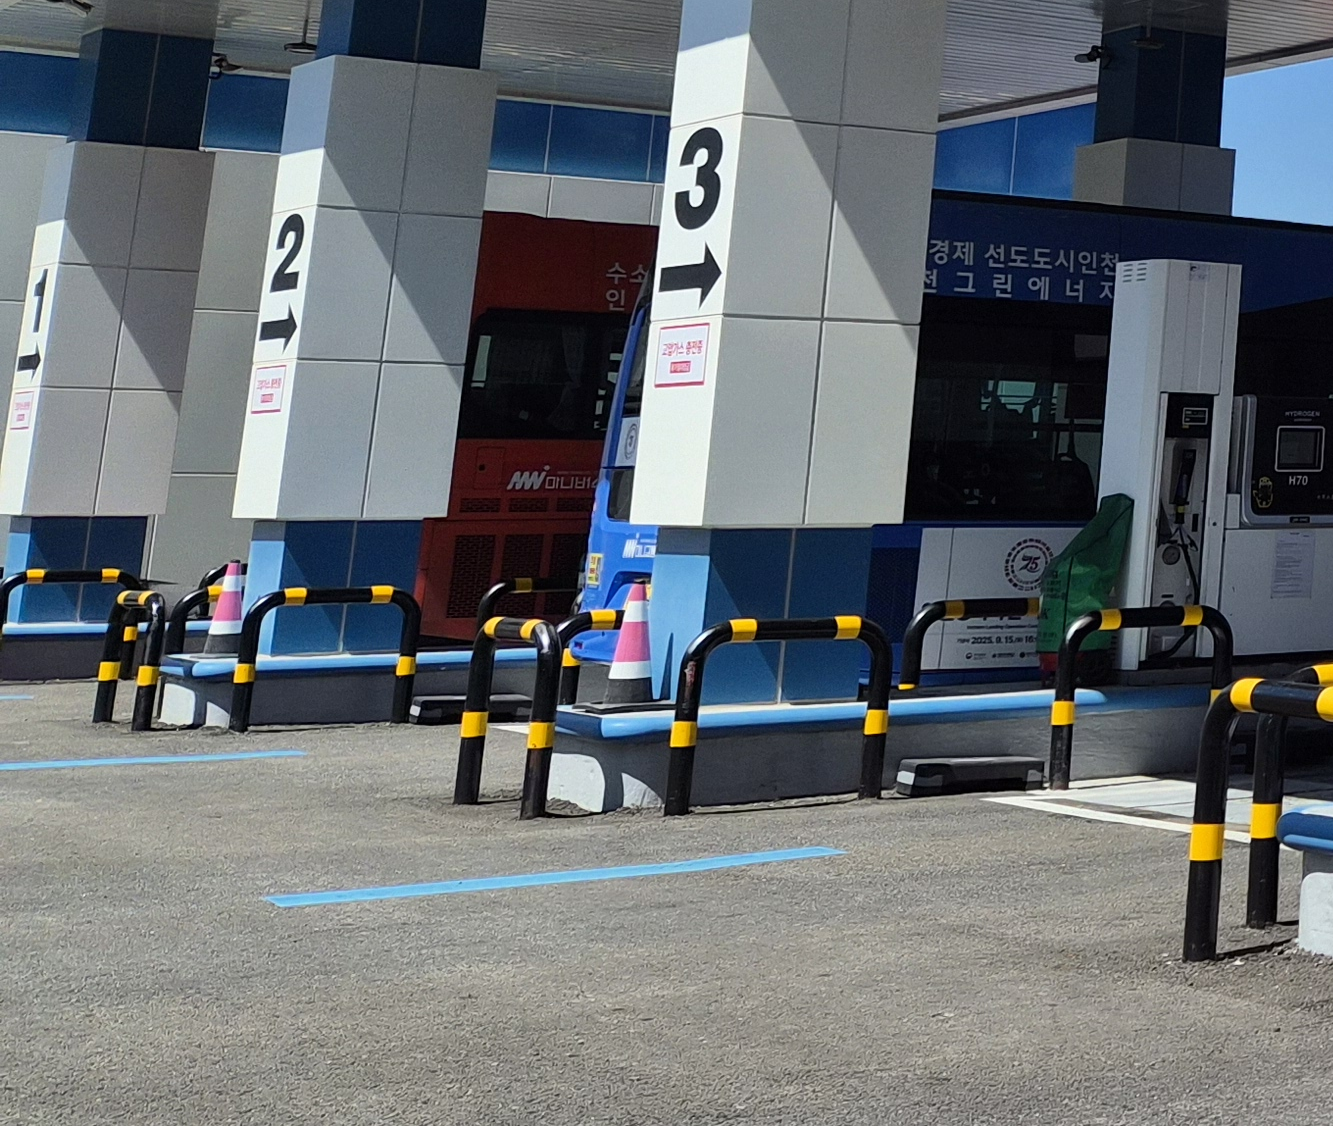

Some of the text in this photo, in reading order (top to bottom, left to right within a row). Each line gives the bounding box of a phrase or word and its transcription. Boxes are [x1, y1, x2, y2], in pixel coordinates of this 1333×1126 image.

[674, 127, 724, 230] 3
[269, 213, 305, 294] 2
[33, 268, 49, 334] 1
[1288, 476, 1309, 486] H70
